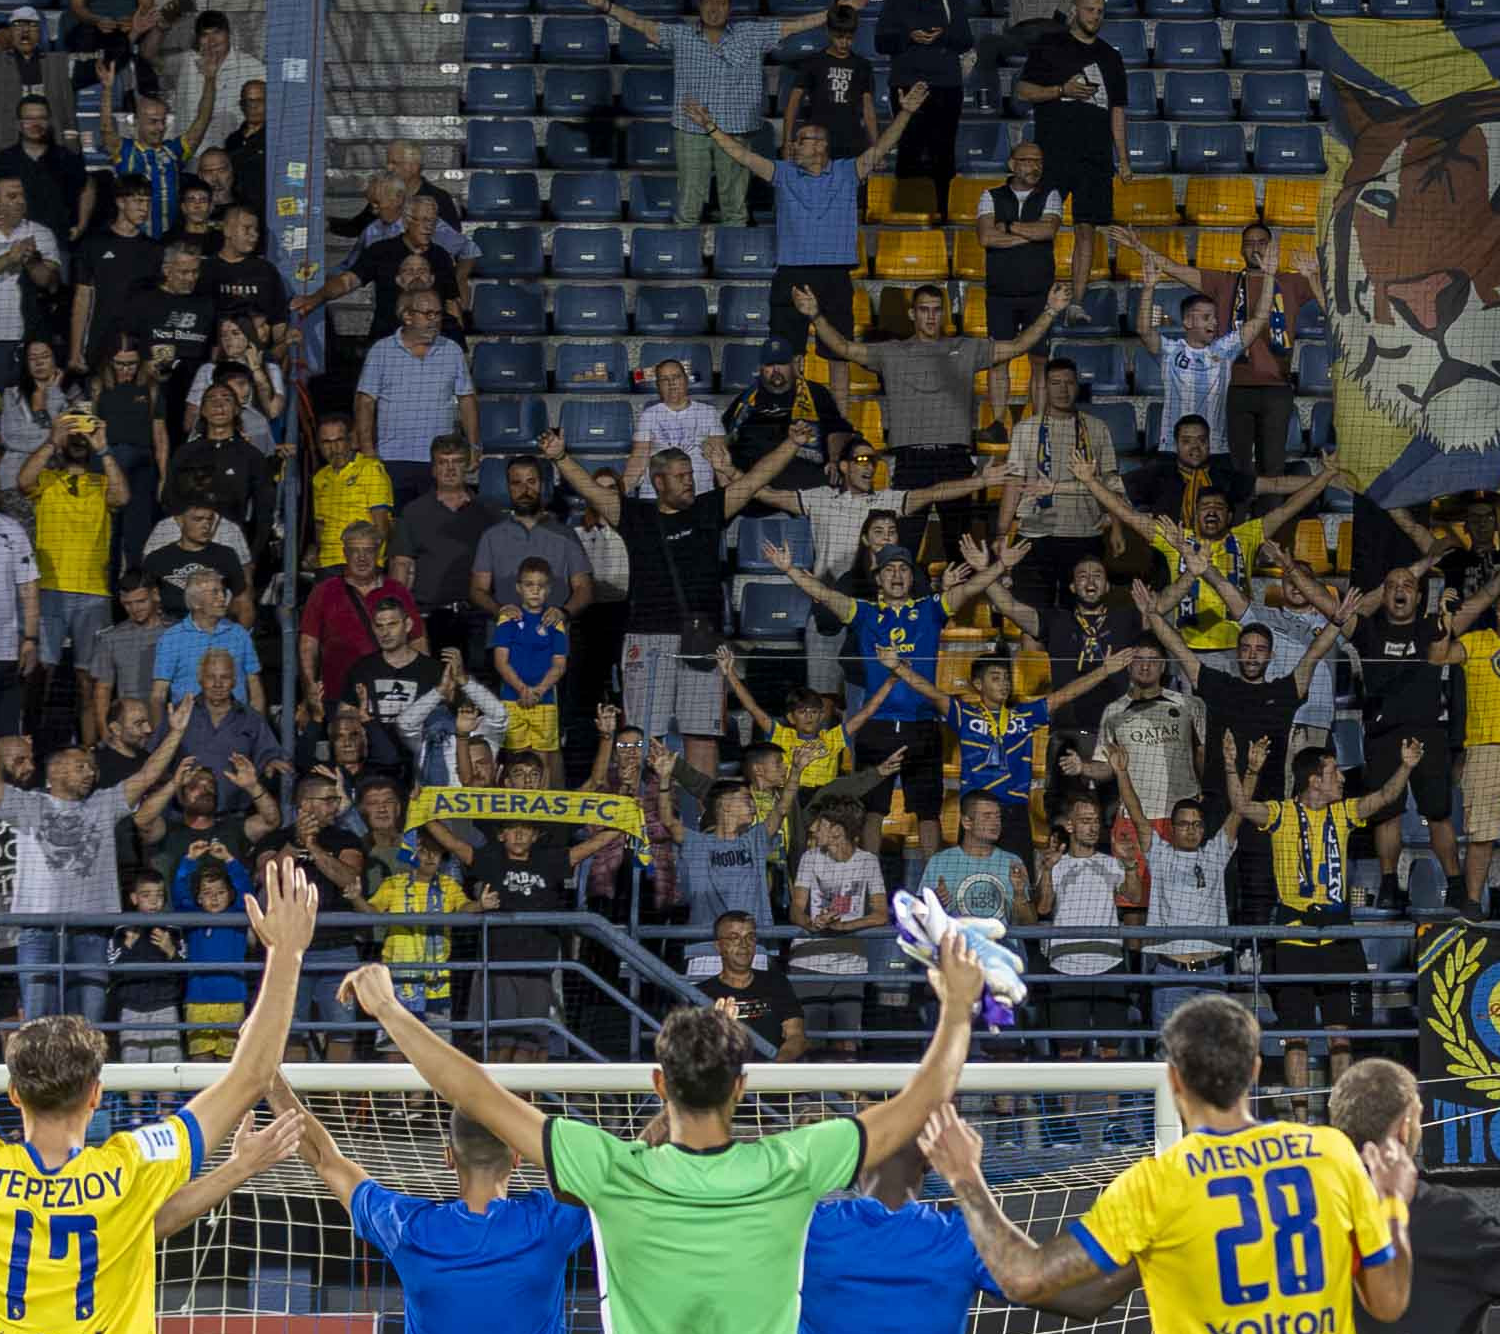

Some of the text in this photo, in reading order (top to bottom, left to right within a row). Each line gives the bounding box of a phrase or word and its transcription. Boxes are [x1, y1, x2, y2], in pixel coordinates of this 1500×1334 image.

[1131, 724, 1180, 744] QATAR
[433, 788, 620, 822] ASTERAS FC
[1328, 824, 1343, 904] ΑΣΤΕΡ
[1185, 1133, 1322, 1177] MENDEZ
[6, 1208, 99, 1322] 17
[1206, 1164, 1325, 1306] 28
